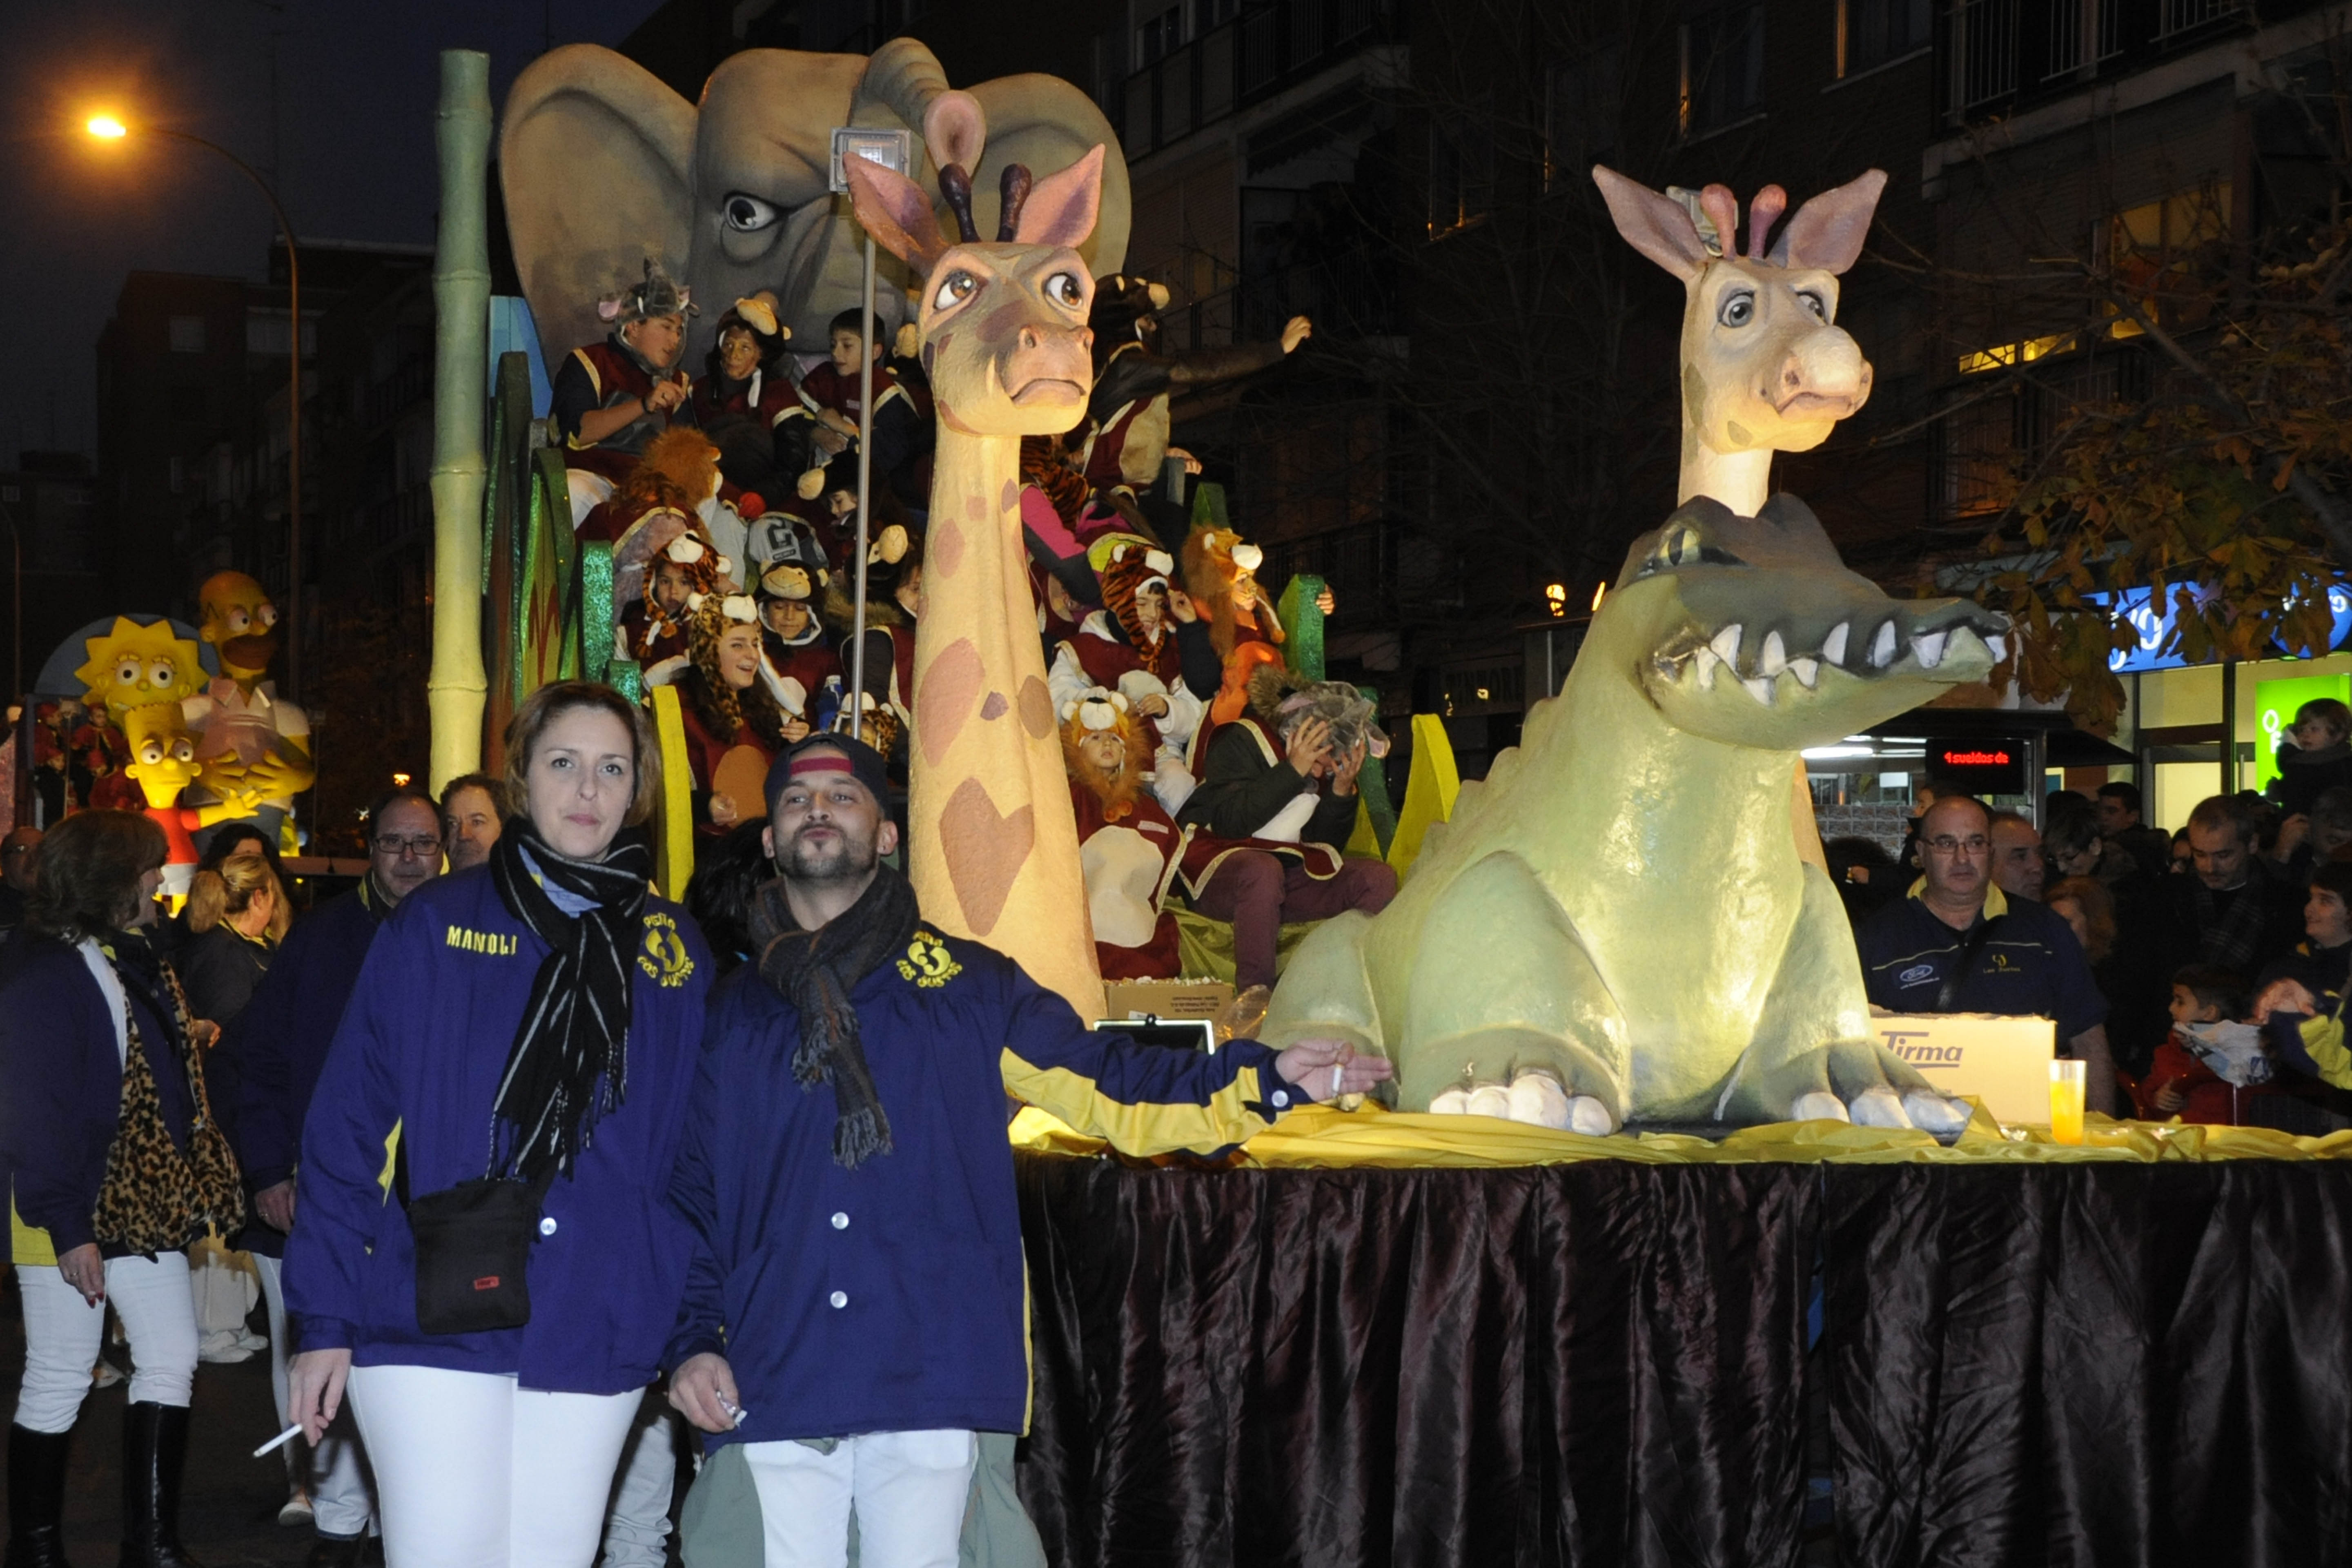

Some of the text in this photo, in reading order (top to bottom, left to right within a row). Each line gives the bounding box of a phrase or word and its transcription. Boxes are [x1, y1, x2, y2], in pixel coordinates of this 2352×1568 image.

[1953, 751, 1993, 764] sueldos
[1995, 751, 2009, 764] de
[446, 924, 517, 956] MANOLI
[1880, 1031, 1963, 1061] Tirma
